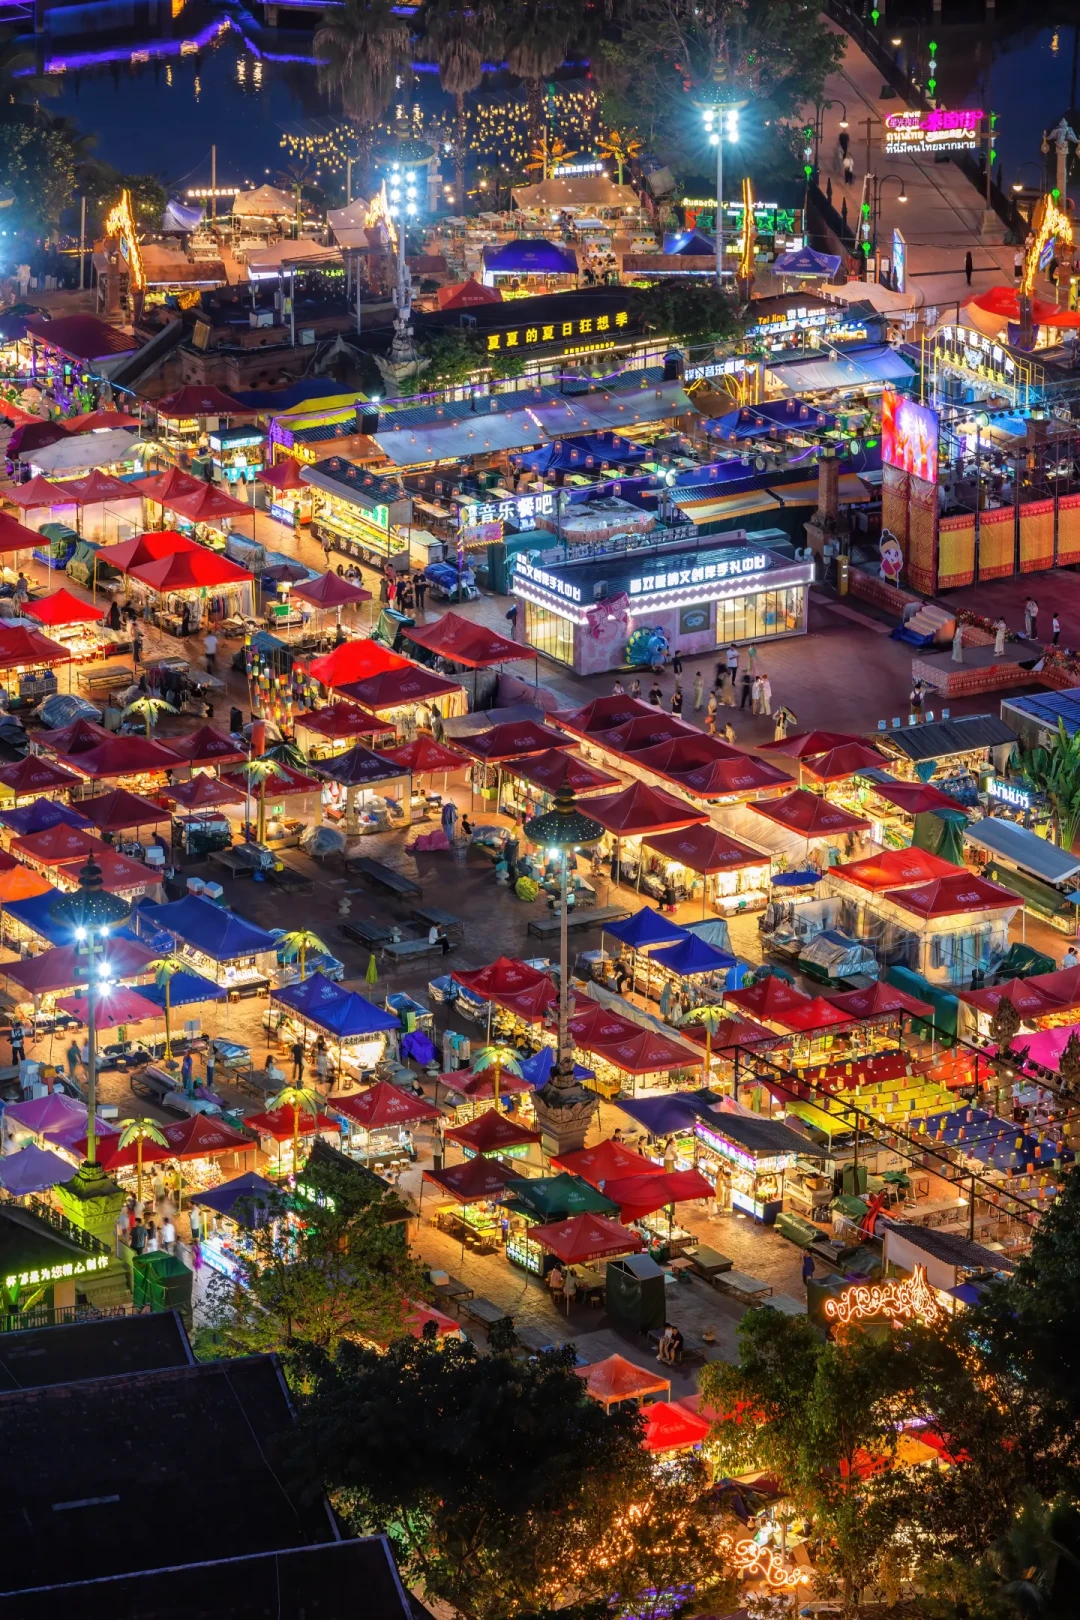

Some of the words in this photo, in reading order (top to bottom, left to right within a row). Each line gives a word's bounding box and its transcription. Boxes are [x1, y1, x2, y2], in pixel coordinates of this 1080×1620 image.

[920, 109, 983, 131] 泰国街
[487, 311, 628, 350] 夏夏的夏日狂想季
